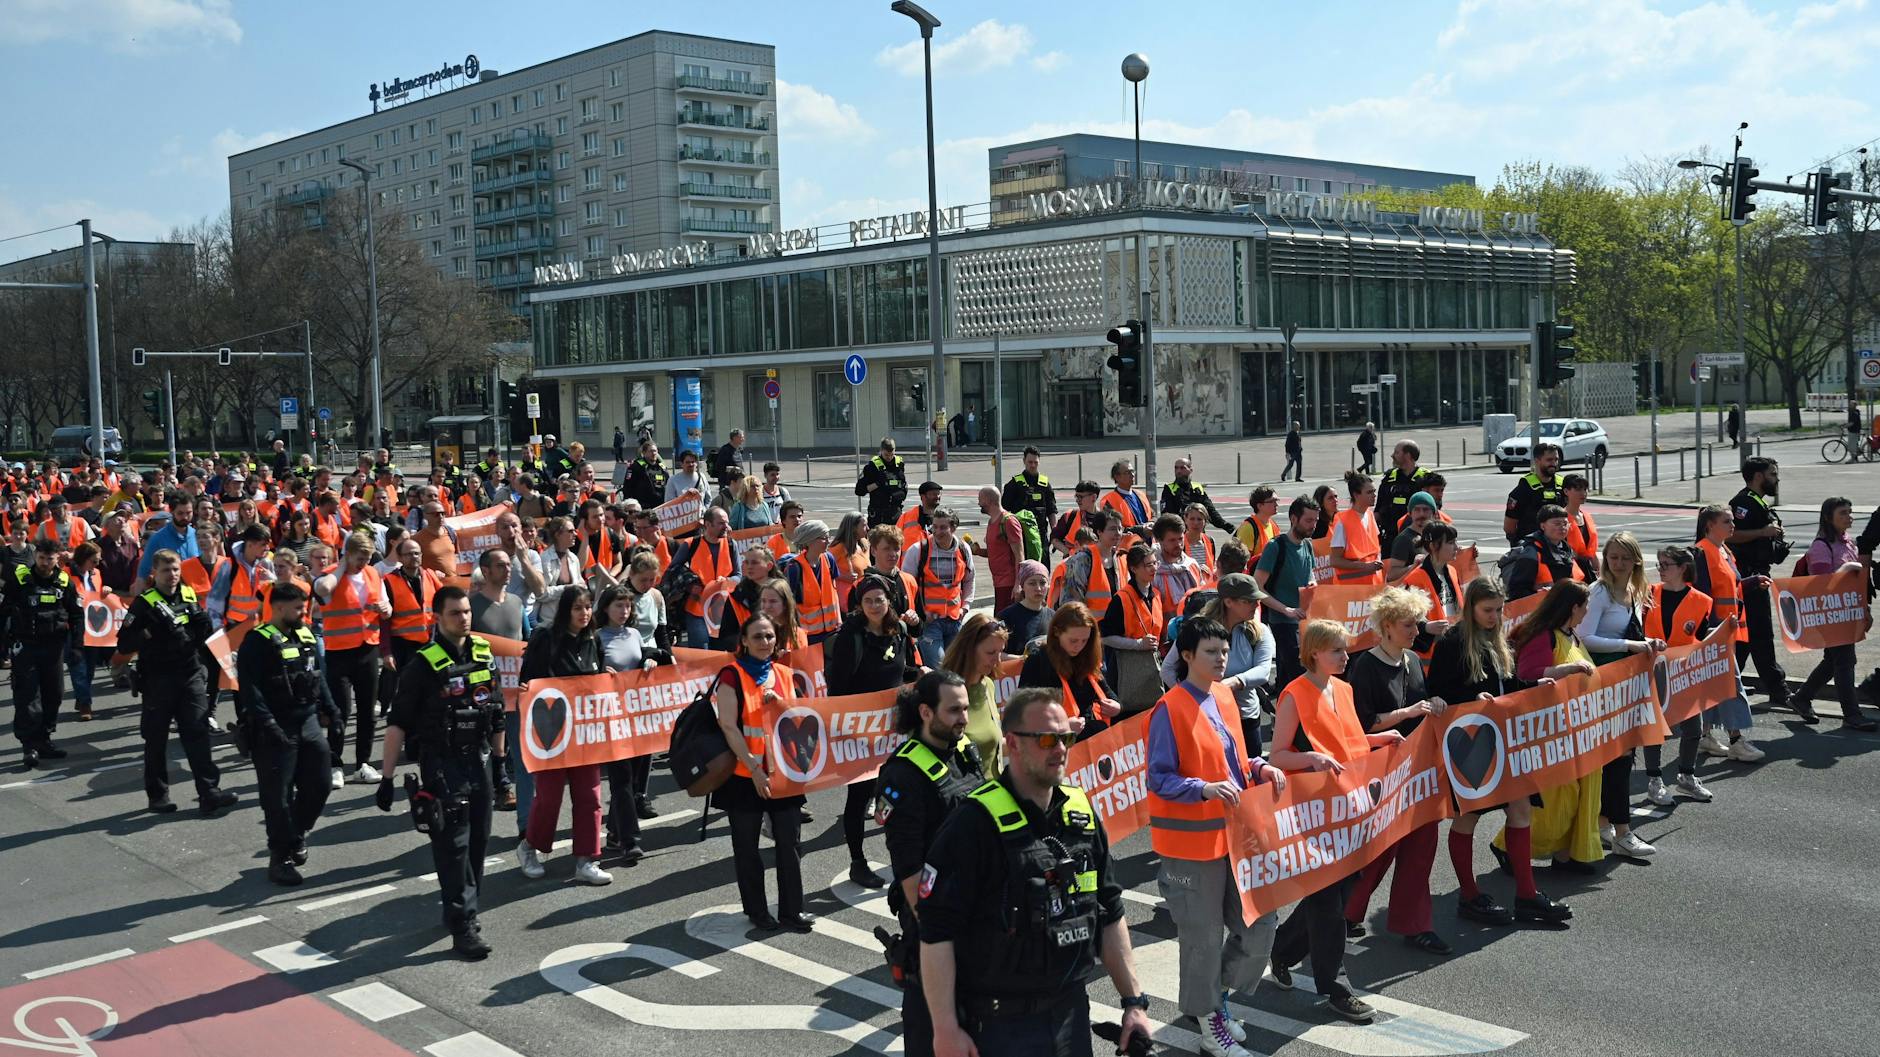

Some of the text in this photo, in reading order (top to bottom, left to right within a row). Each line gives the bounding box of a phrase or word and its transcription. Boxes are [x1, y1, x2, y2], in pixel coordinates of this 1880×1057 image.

[1028, 181, 1123, 217] MOSKAU
[282, 400, 292, 412] P
[1800, 596, 1820, 613] ART.
[1820, 594, 1842, 610] 20A
[1843, 591, 1858, 607] GG
[1801, 613, 1826, 628] LEBEN
[1704, 643, 1718, 662] GG
[1670, 658, 1730, 695] LEBEN SCHÜTZEN
[1505, 671, 1651, 748] LETZTE GENERATION
[575, 722, 607, 746] VOR
[830, 736, 870, 764] VOR
[1508, 702, 1657, 777] VOR DEN KIPPPUNKTEN
[1236, 766, 1440, 894] GESELLSCHAFTSRAT JETZT!
[1274, 799, 1326, 841] MEHR
